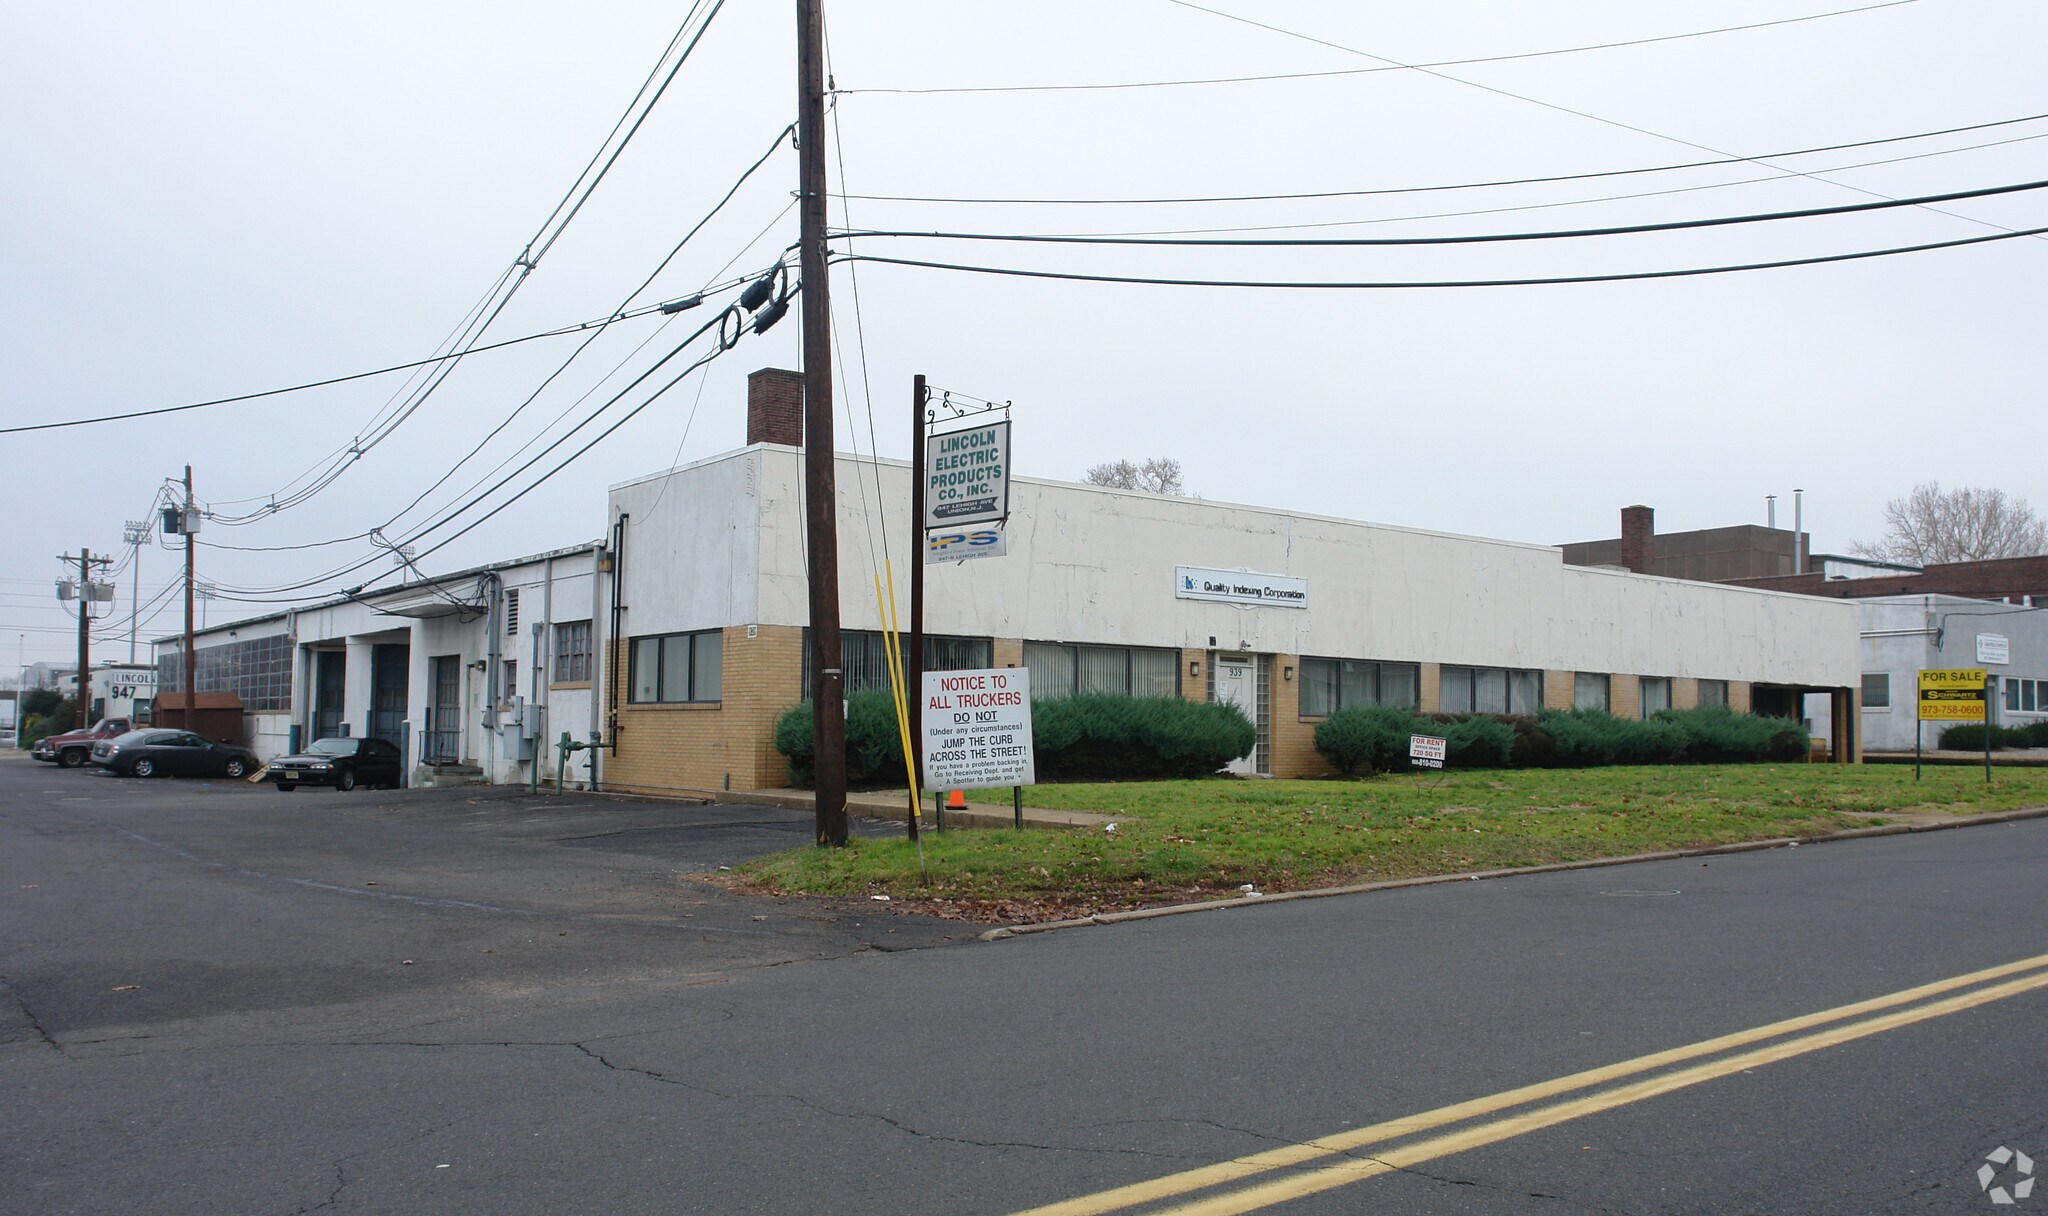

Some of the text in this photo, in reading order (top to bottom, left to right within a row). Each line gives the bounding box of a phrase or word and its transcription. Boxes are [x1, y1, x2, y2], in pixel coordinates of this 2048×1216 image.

[940, 429, 996, 454] LINCOLN
[935, 447, 999, 471] ELECTRIC
[931, 464, 1002, 489] PRODUCTS
[938, 482, 993, 500] CO., INC.
[951, 501, 978, 509] LEHIGH
[930, 530, 999, 551] IPS
[1203, 581, 1305, 600] Quality Indexing Corporation
[1229, 668, 1242, 676] 939
[1923, 671, 1982, 681] FOR SALE
[941, 675, 1007, 692] NOTICE TO
[112, 685, 136, 699] 947
[1927, 690, 1977, 699] SCHWARTZ
[929, 691, 1022, 710] ALL TRUCKERS
[953, 710, 998, 723] DO NOT
[1921, 705, 1984, 714] 973-758-0600
[930, 722, 1023, 737] (Under any circumstances)
[941, 734, 1013, 749] JUMP THE CURB
[929, 745, 1027, 763] ACROSS THE STREET!
[949, 762, 964, 770] have
[971, 759, 996, 768] problem
[997, 759, 1020, 767] backing
[952, 776, 975, 784] Spotter
[985, 775, 1002, 783] guide
[954, 768, 983, 777] Receiving
